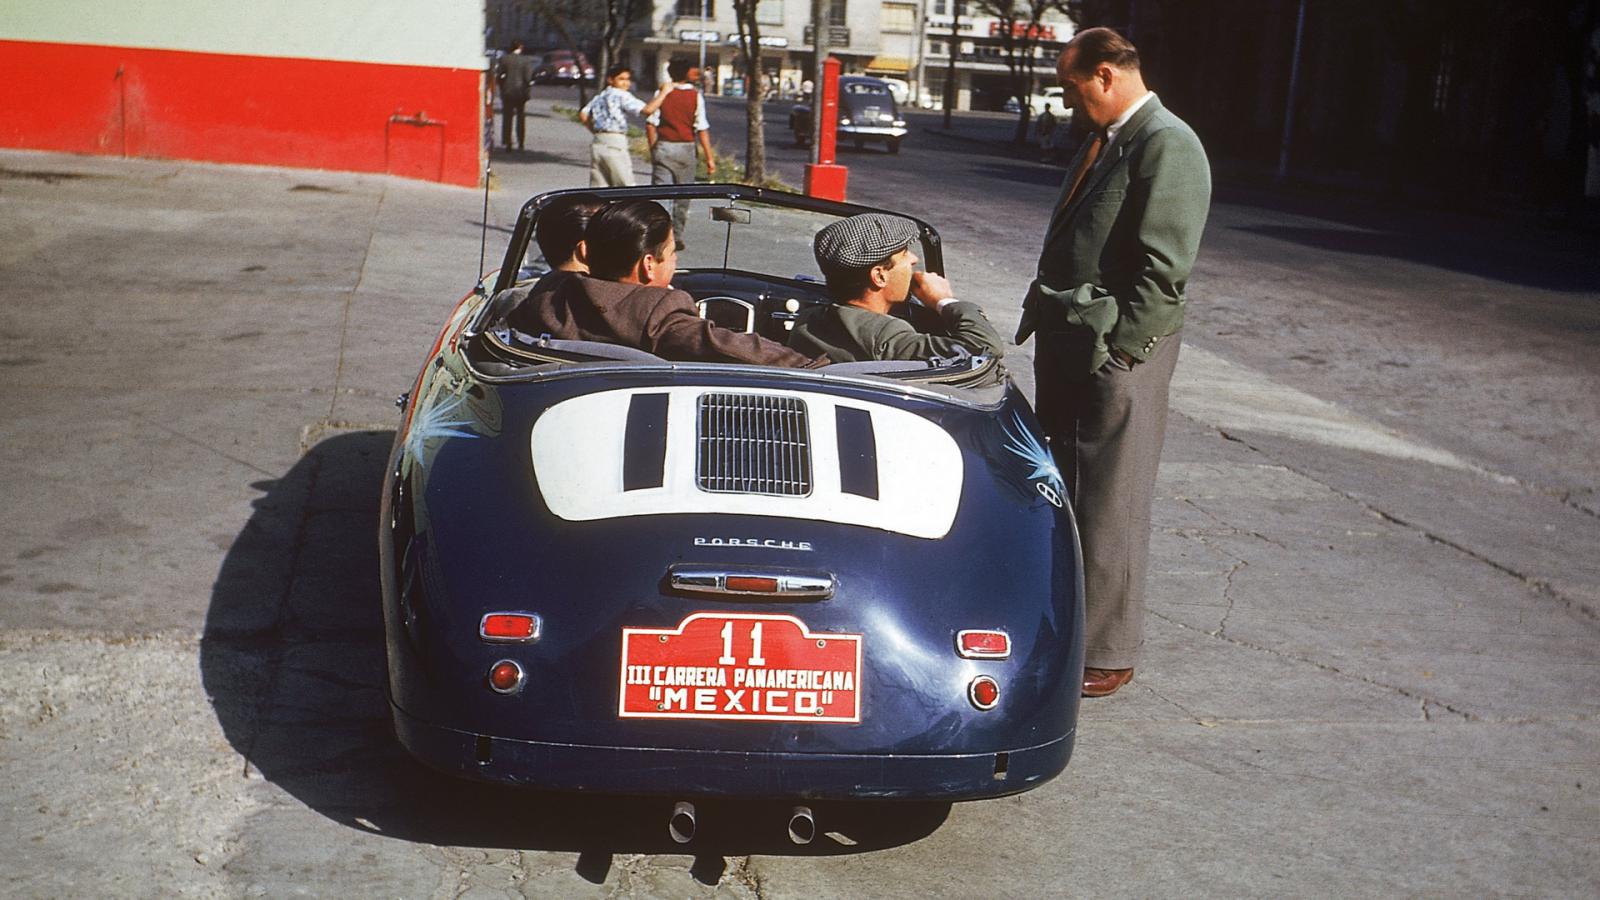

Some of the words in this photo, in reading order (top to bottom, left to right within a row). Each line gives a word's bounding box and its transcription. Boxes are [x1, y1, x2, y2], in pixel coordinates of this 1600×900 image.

[693, 537, 813, 551] PORSCHE
[718, 621, 766, 666] 11
[627, 665, 651, 685] III
[653, 666, 727, 687] CARRERA
[734, 668, 854, 691] PANAMERICANA
[649, 686, 833, 714] "MEXICO"
